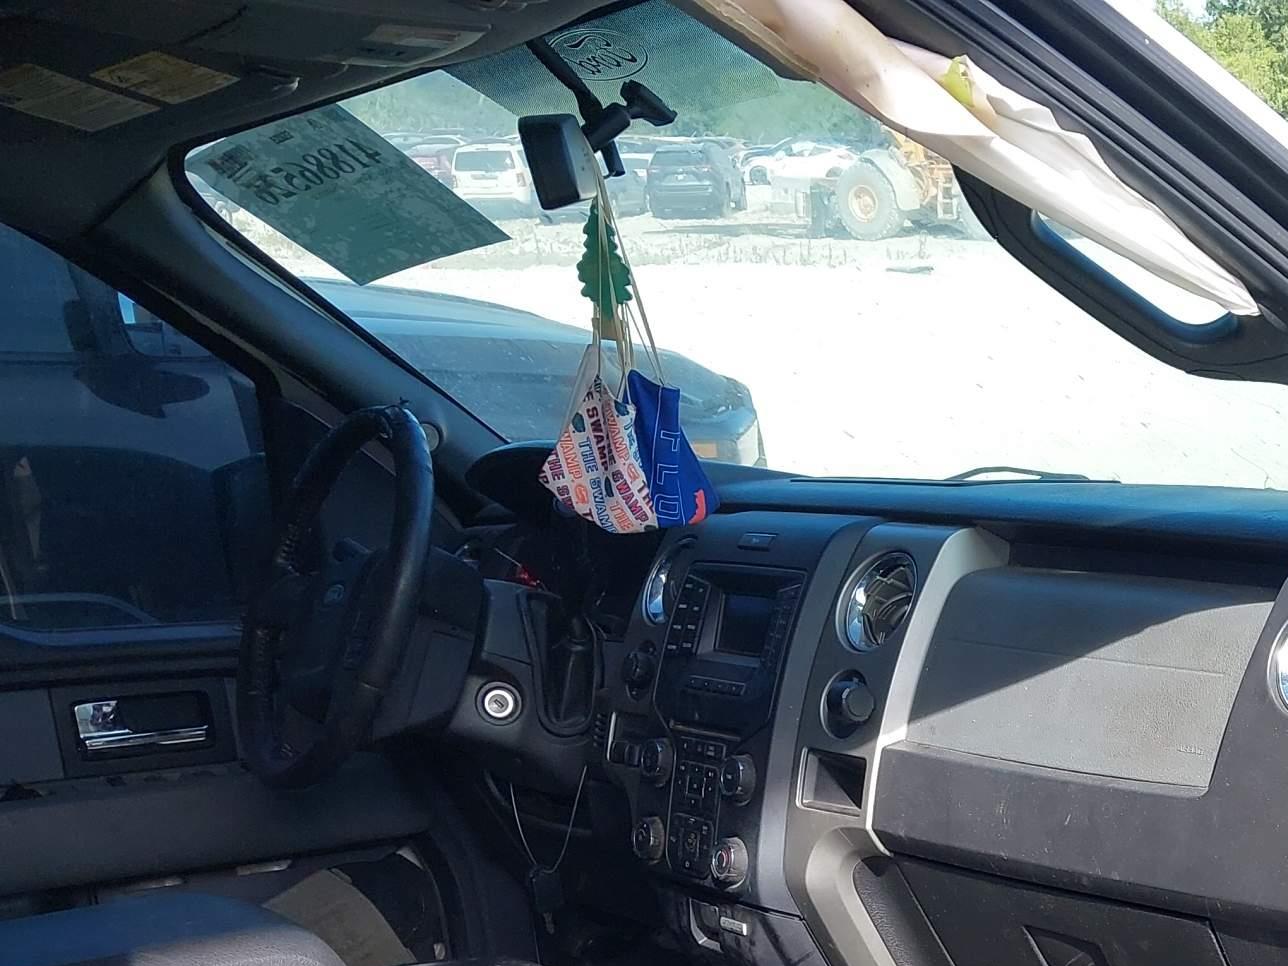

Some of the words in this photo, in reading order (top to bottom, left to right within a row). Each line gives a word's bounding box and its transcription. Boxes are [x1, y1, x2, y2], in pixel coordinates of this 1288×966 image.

[579, 437, 599, 474] THE
[586, 406, 608, 472] SWAMP
[609, 500, 635, 531] THE
